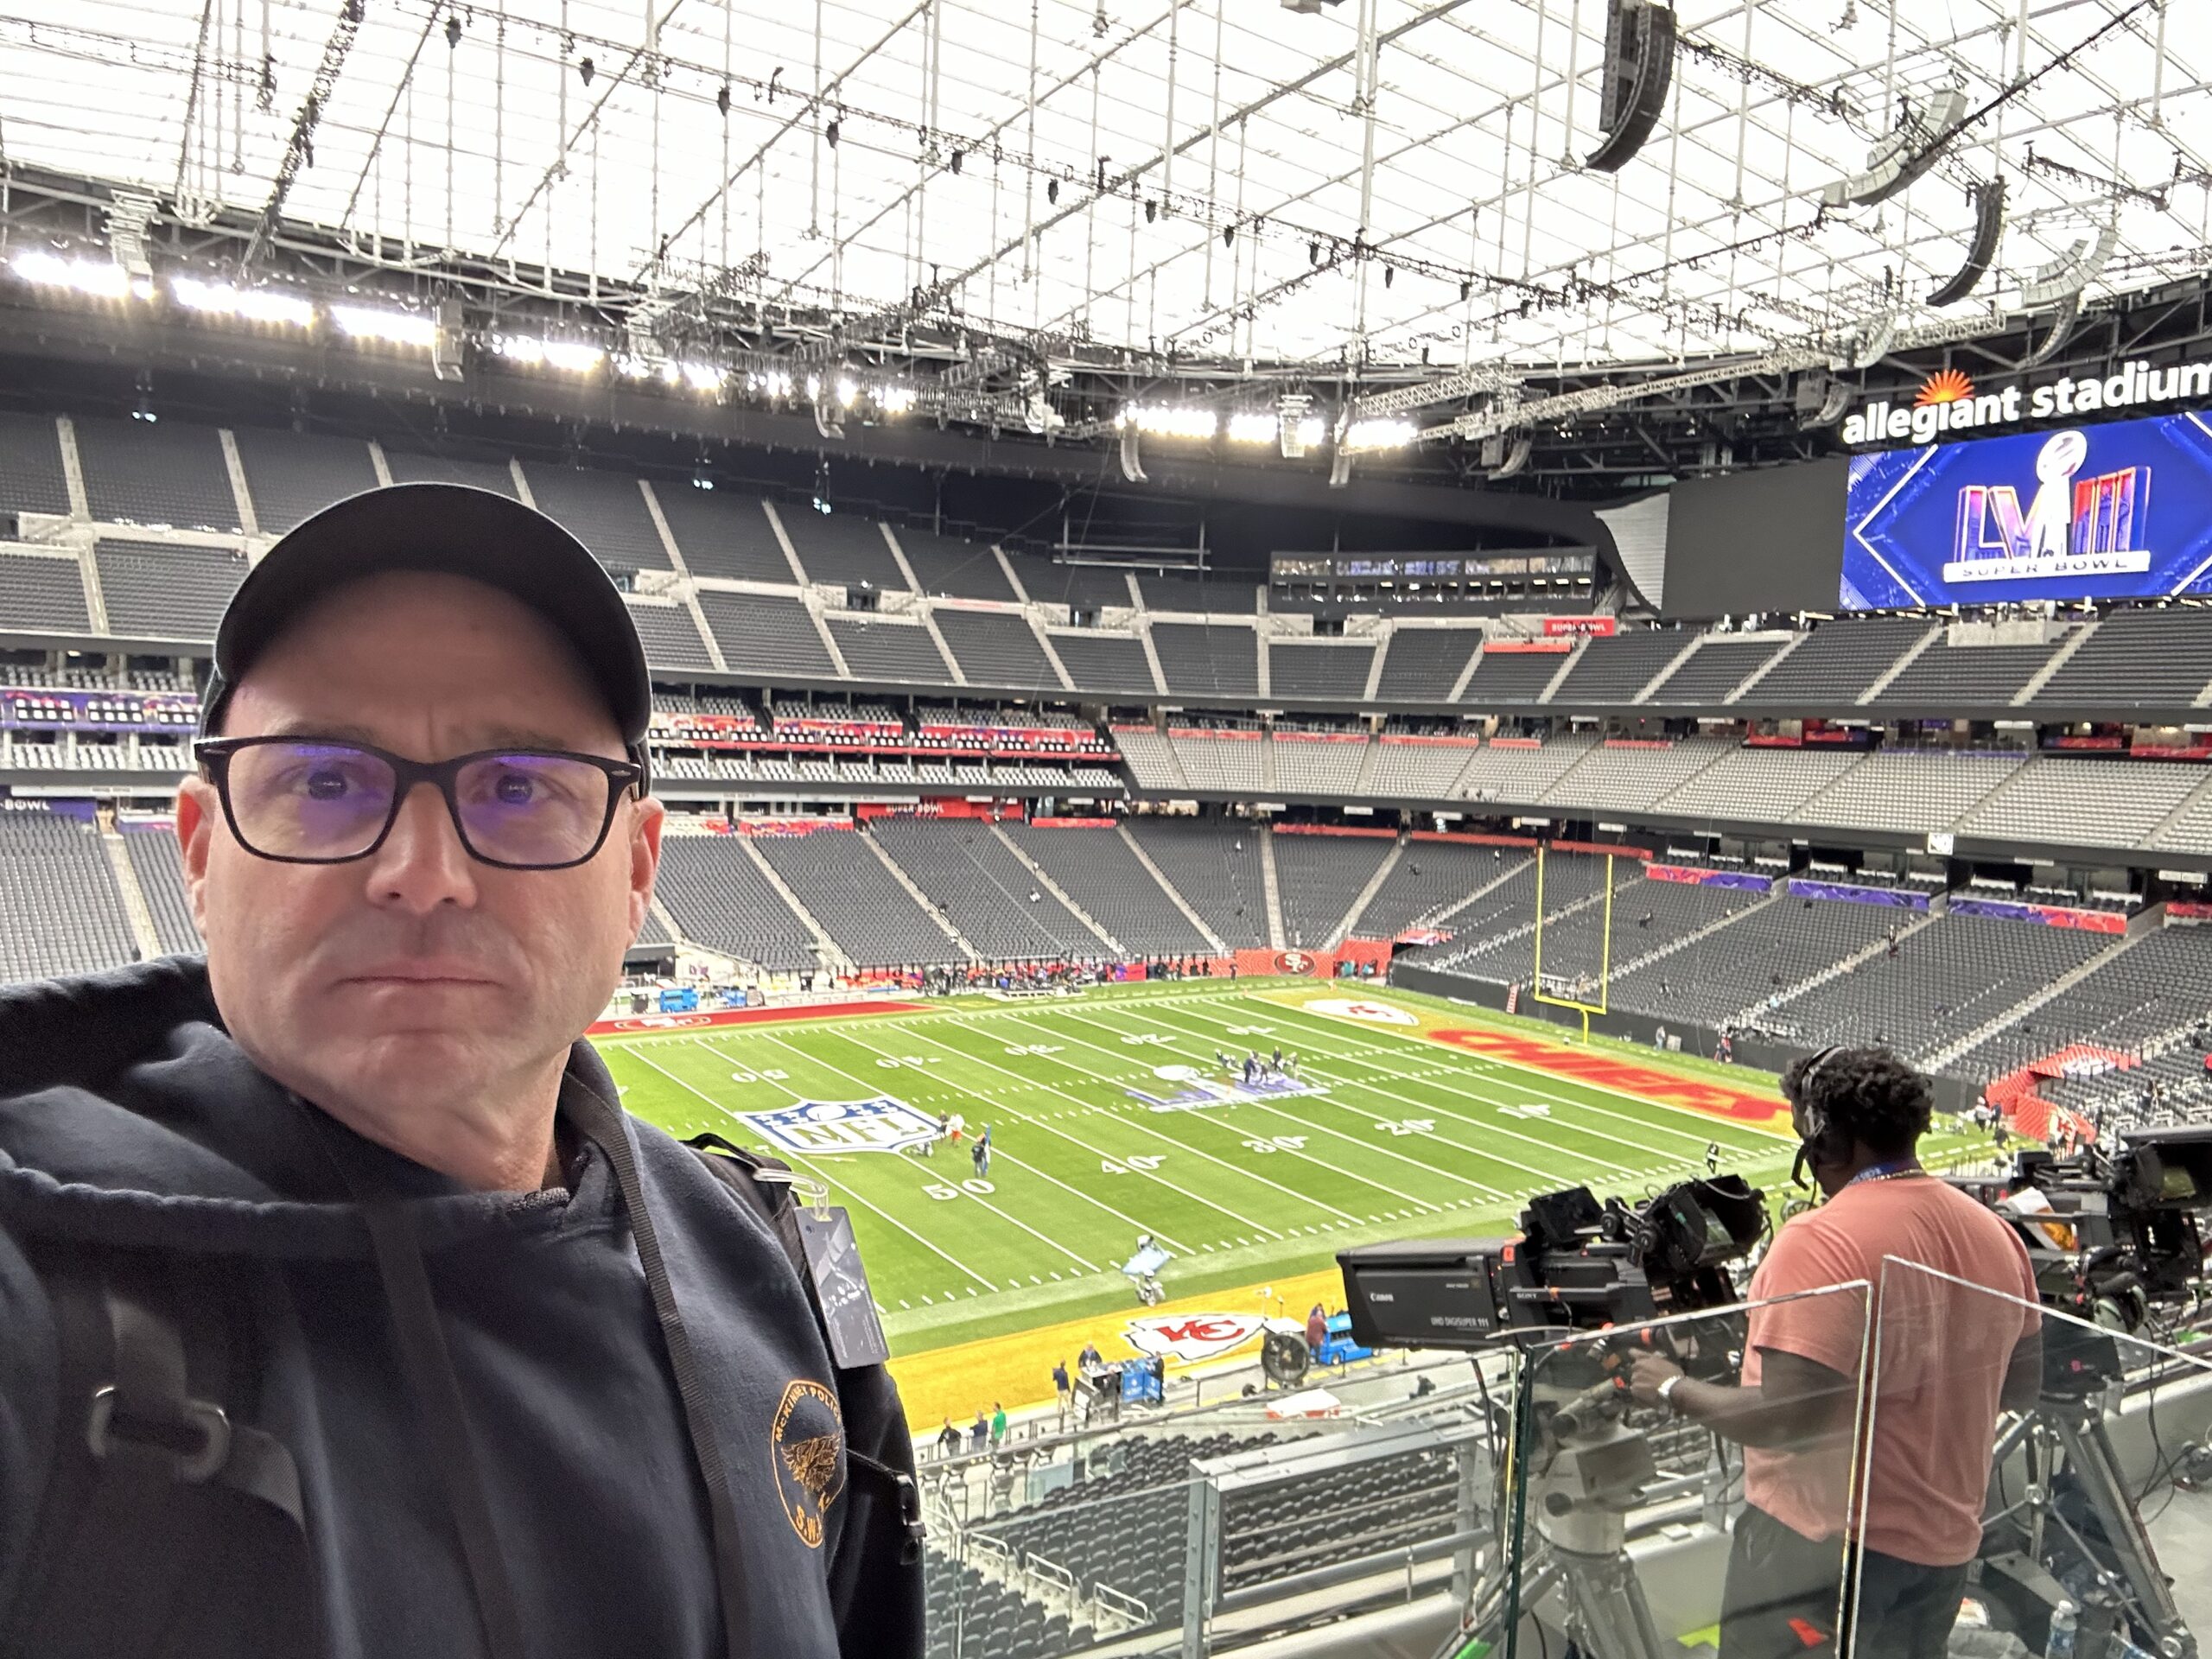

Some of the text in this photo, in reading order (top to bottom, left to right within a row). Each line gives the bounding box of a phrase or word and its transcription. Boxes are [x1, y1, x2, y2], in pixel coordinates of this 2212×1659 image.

[1842, 359, 2212, 443] allegiant stadium
[1961, 558, 2128, 577] SUPER BOWL
[731, 1068, 791, 1083] 50
[788, 1116, 930, 1146] NFL
[1241, 1136, 1305, 1154] 30
[1101, 1155, 1160, 1175] 40
[921, 1179, 995, 1201] 50
[1370, 1292, 1395, 1302] Canon
